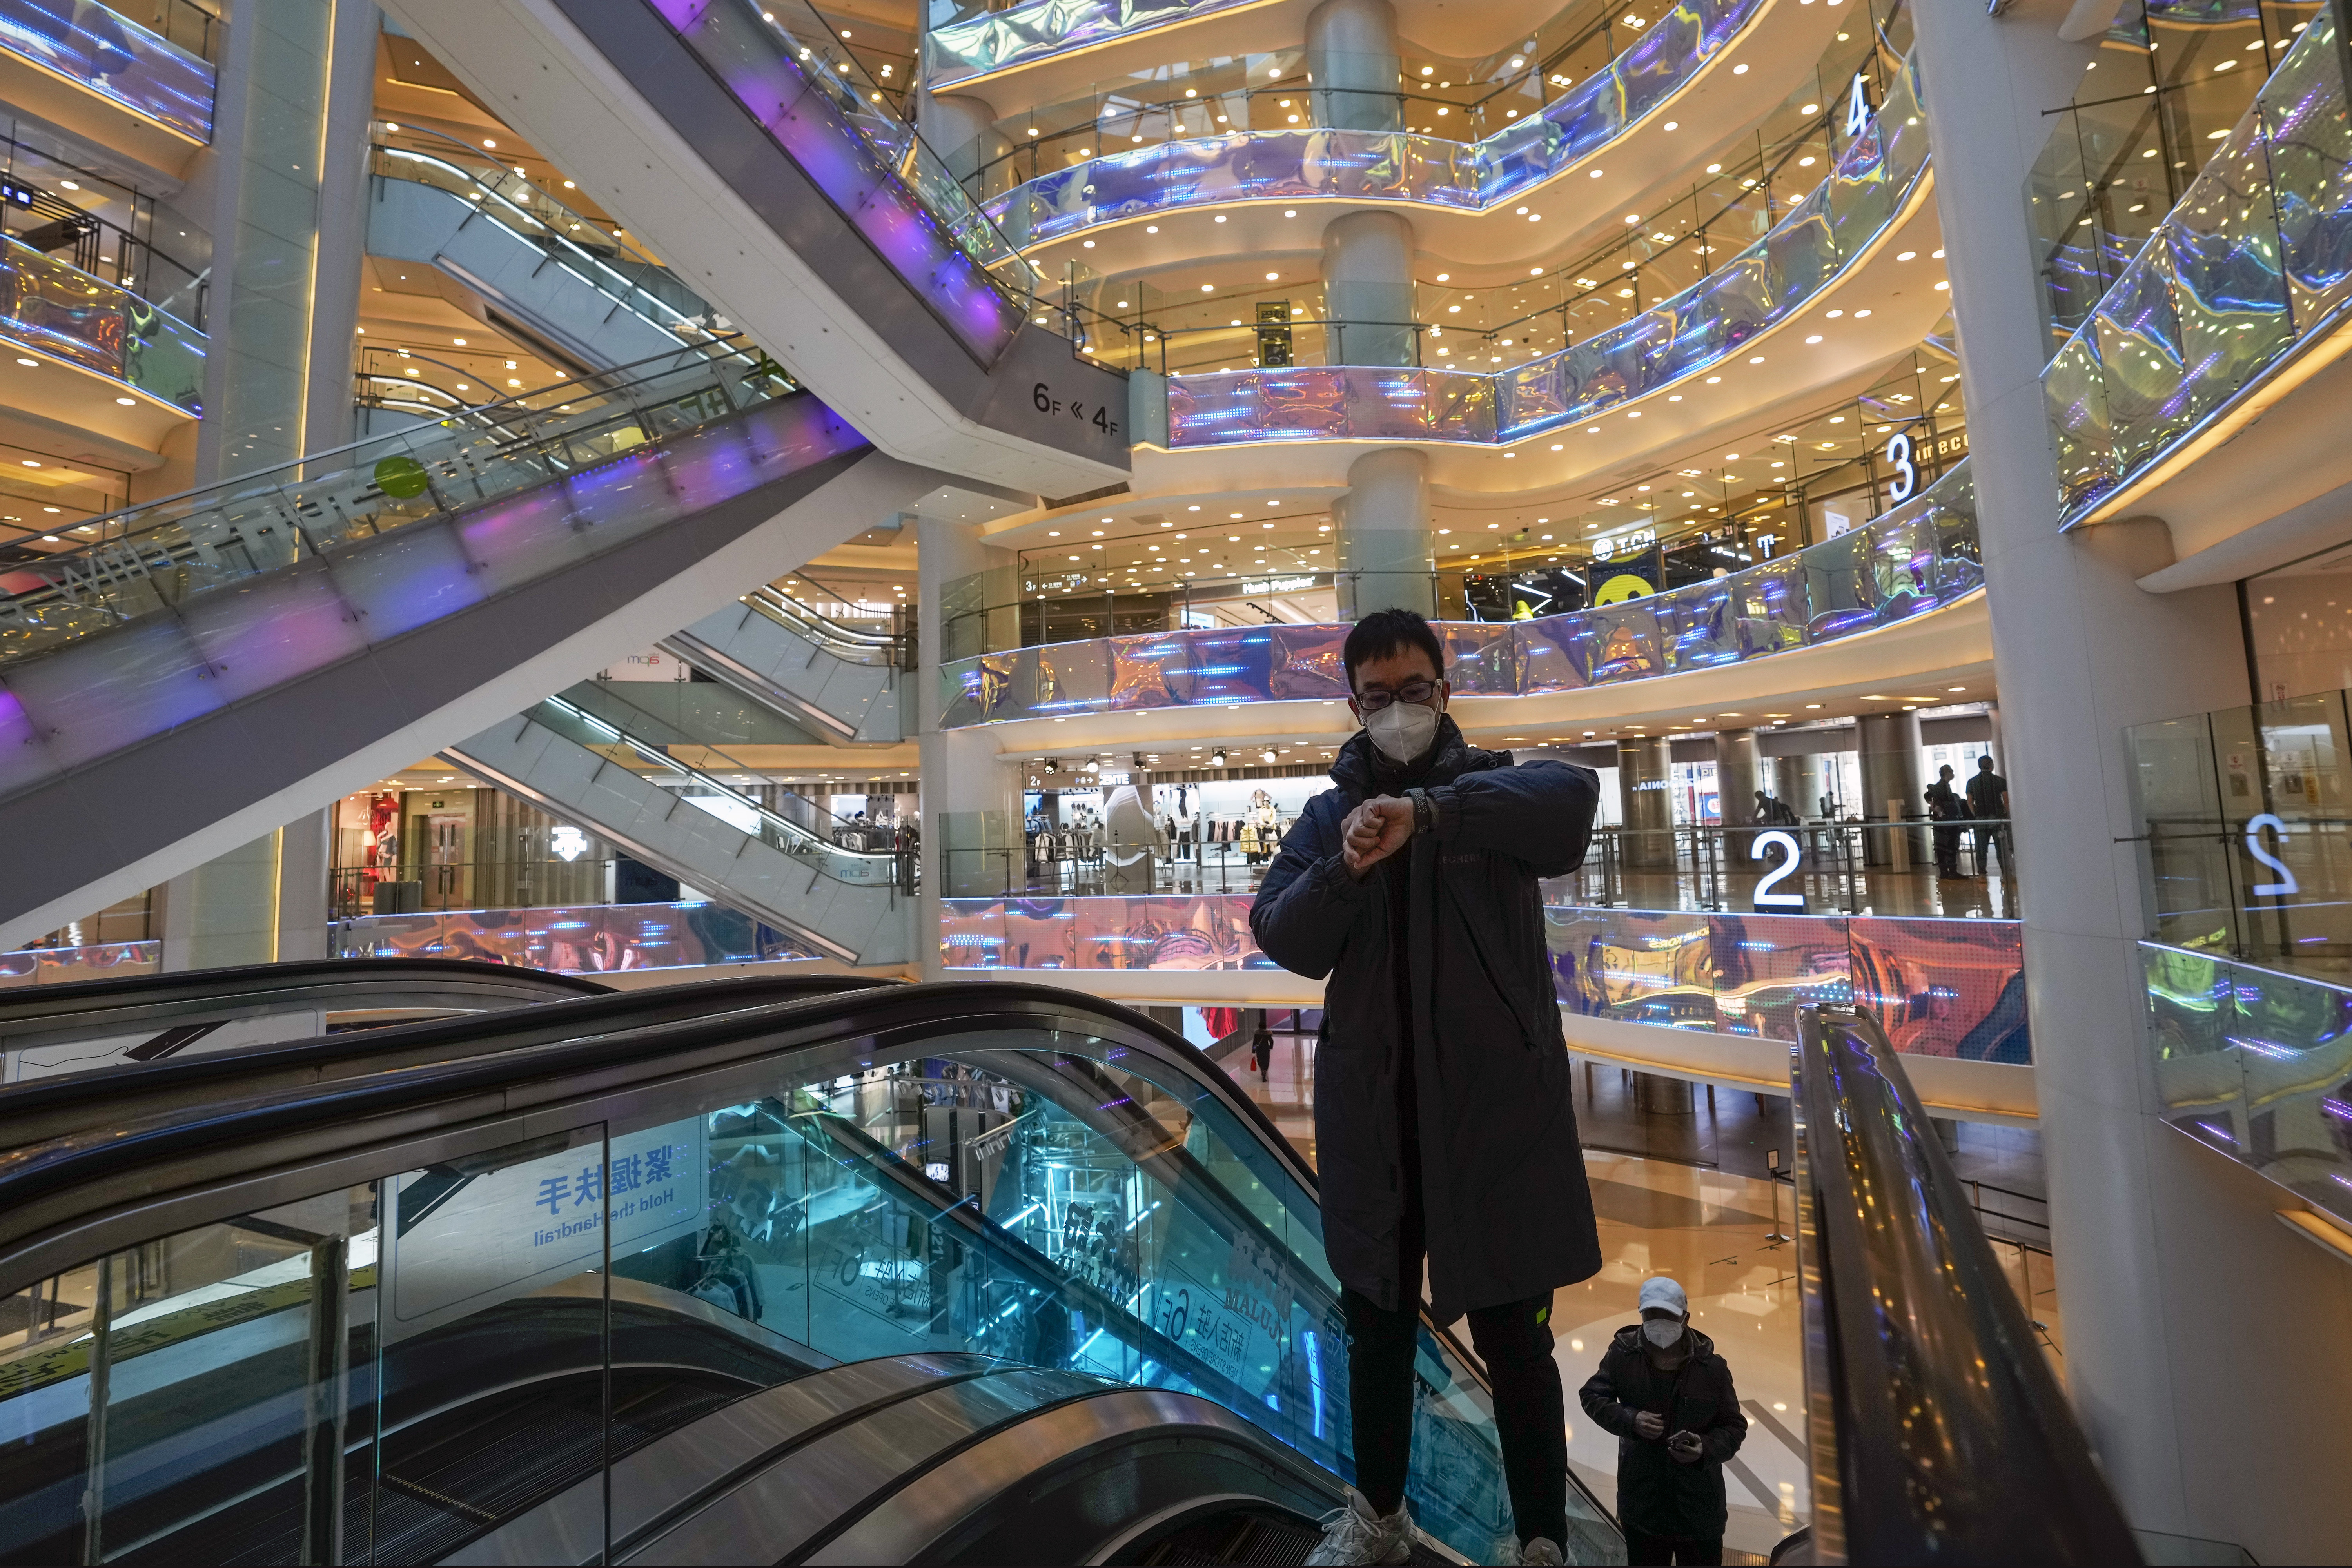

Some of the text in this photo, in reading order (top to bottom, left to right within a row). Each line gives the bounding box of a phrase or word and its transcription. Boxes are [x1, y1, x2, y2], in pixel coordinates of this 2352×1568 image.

[1847, 73, 1869, 137] 4
[1033, 382, 1118, 437] 6F 4F
[1887, 433, 1914, 502] 3
[1025, 581, 1036, 592] 3F
[1242, 576, 1315, 594] Hush Puppies
[1030, 775, 1041, 786] 2F
[1751, 829, 1804, 906] 2
[1223, 1287, 1285, 1350] MALUJI
